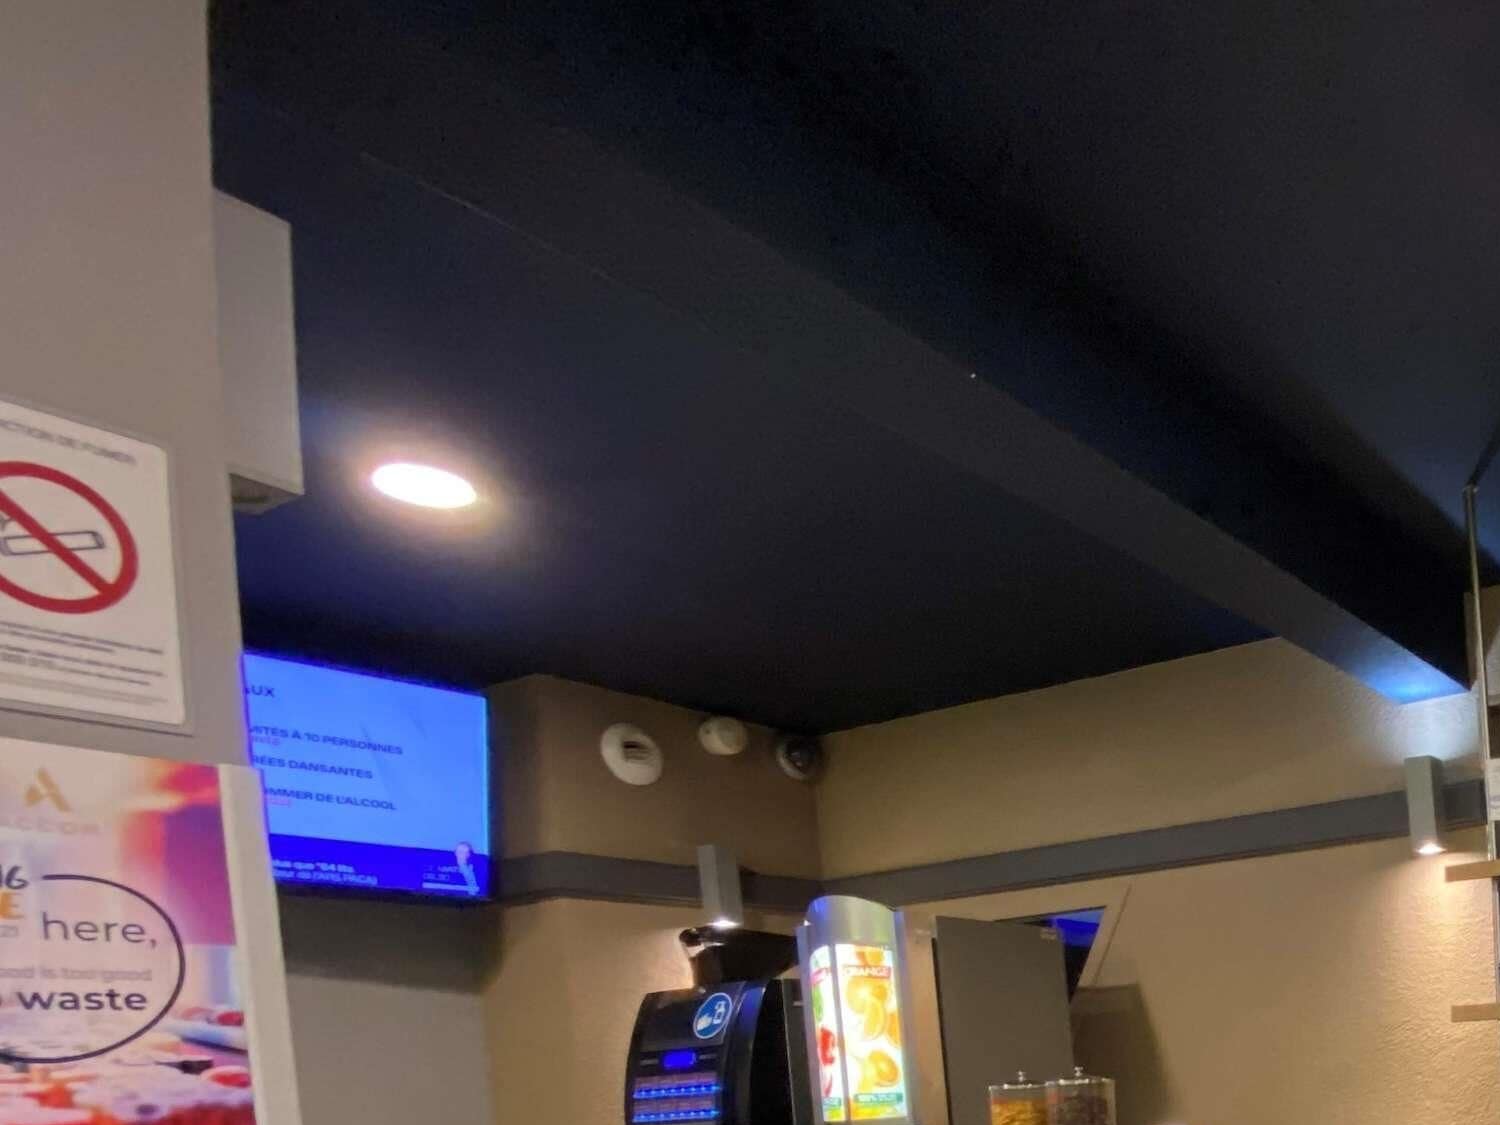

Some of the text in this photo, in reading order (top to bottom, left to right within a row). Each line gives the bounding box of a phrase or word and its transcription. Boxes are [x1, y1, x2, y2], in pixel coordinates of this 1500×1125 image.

[245, 685, 275, 698] UX
[304, 732, 321, 743] 10
[322, 735, 403, 755] PERSONNES
[288, 759, 373, 779] DANSANTES
[315, 792, 334, 804] DE
[42, 911, 157, 948] here,
[17, 988, 148, 1011] waste
